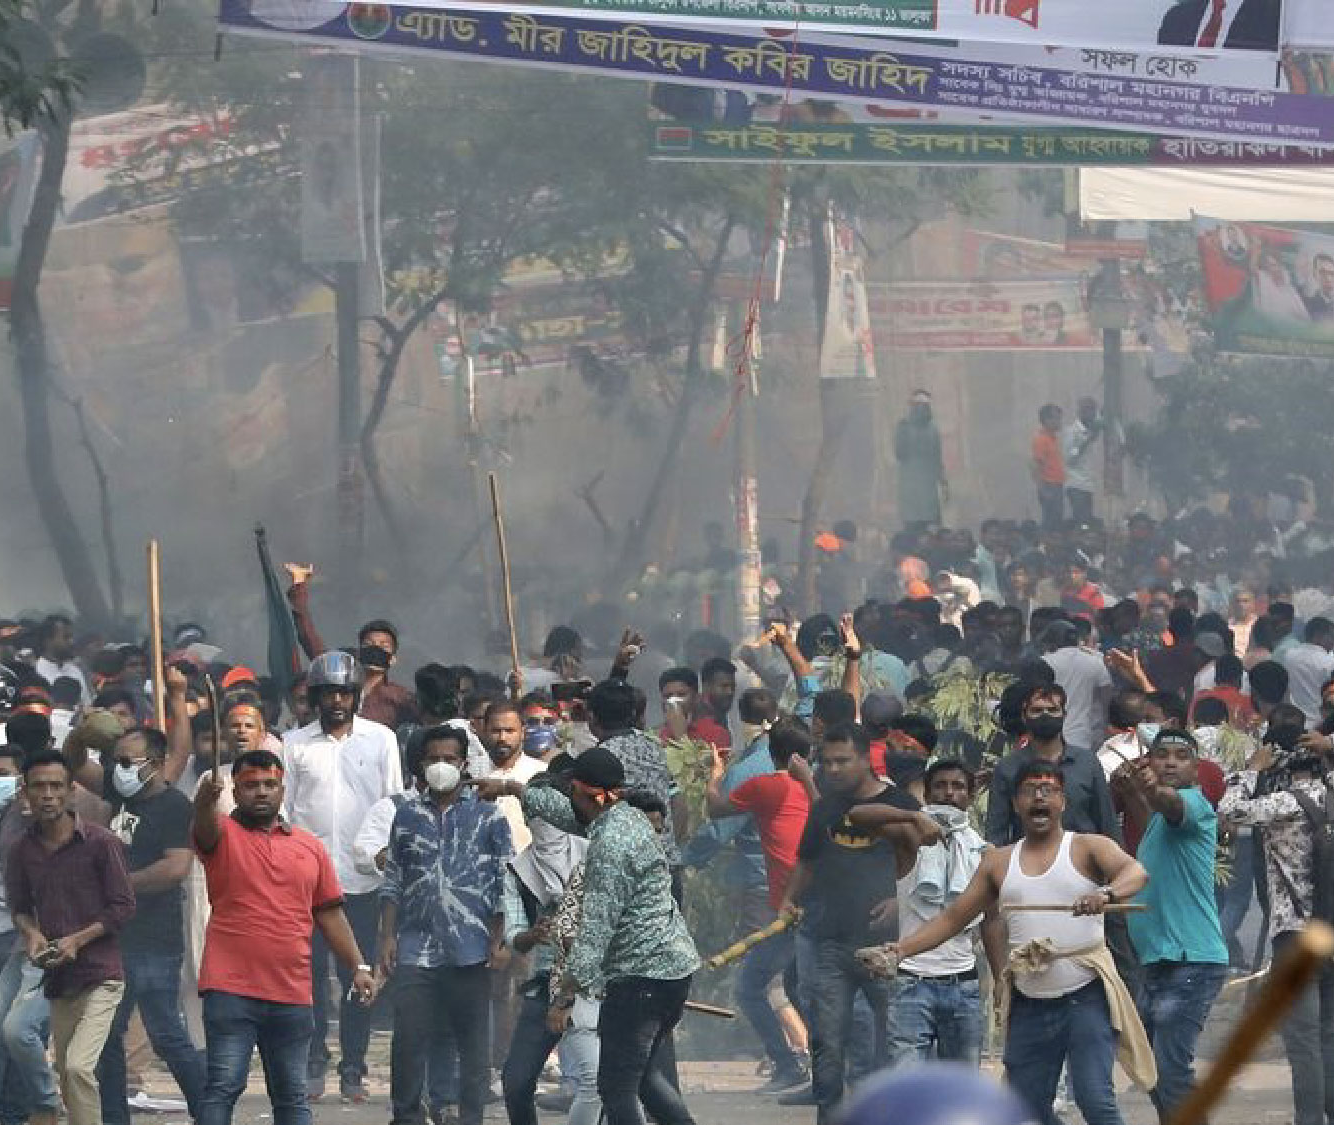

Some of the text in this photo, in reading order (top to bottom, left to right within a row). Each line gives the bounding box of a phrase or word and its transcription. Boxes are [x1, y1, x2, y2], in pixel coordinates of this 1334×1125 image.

[395, 11, 934, 95] এ্যাড. মীর জাহিদুল কবির জাহিদ
[1080, 48, 1200, 79] সফল হোক
[940, 62, 993, 79] সদস্য
[1132, 81, 1201, 101] মহানগর
[1208, 88, 1275, 108] বিএনপি
[703, 124, 855, 157] সাইফুল
[868, 126, 1012, 156] ইসলাম
